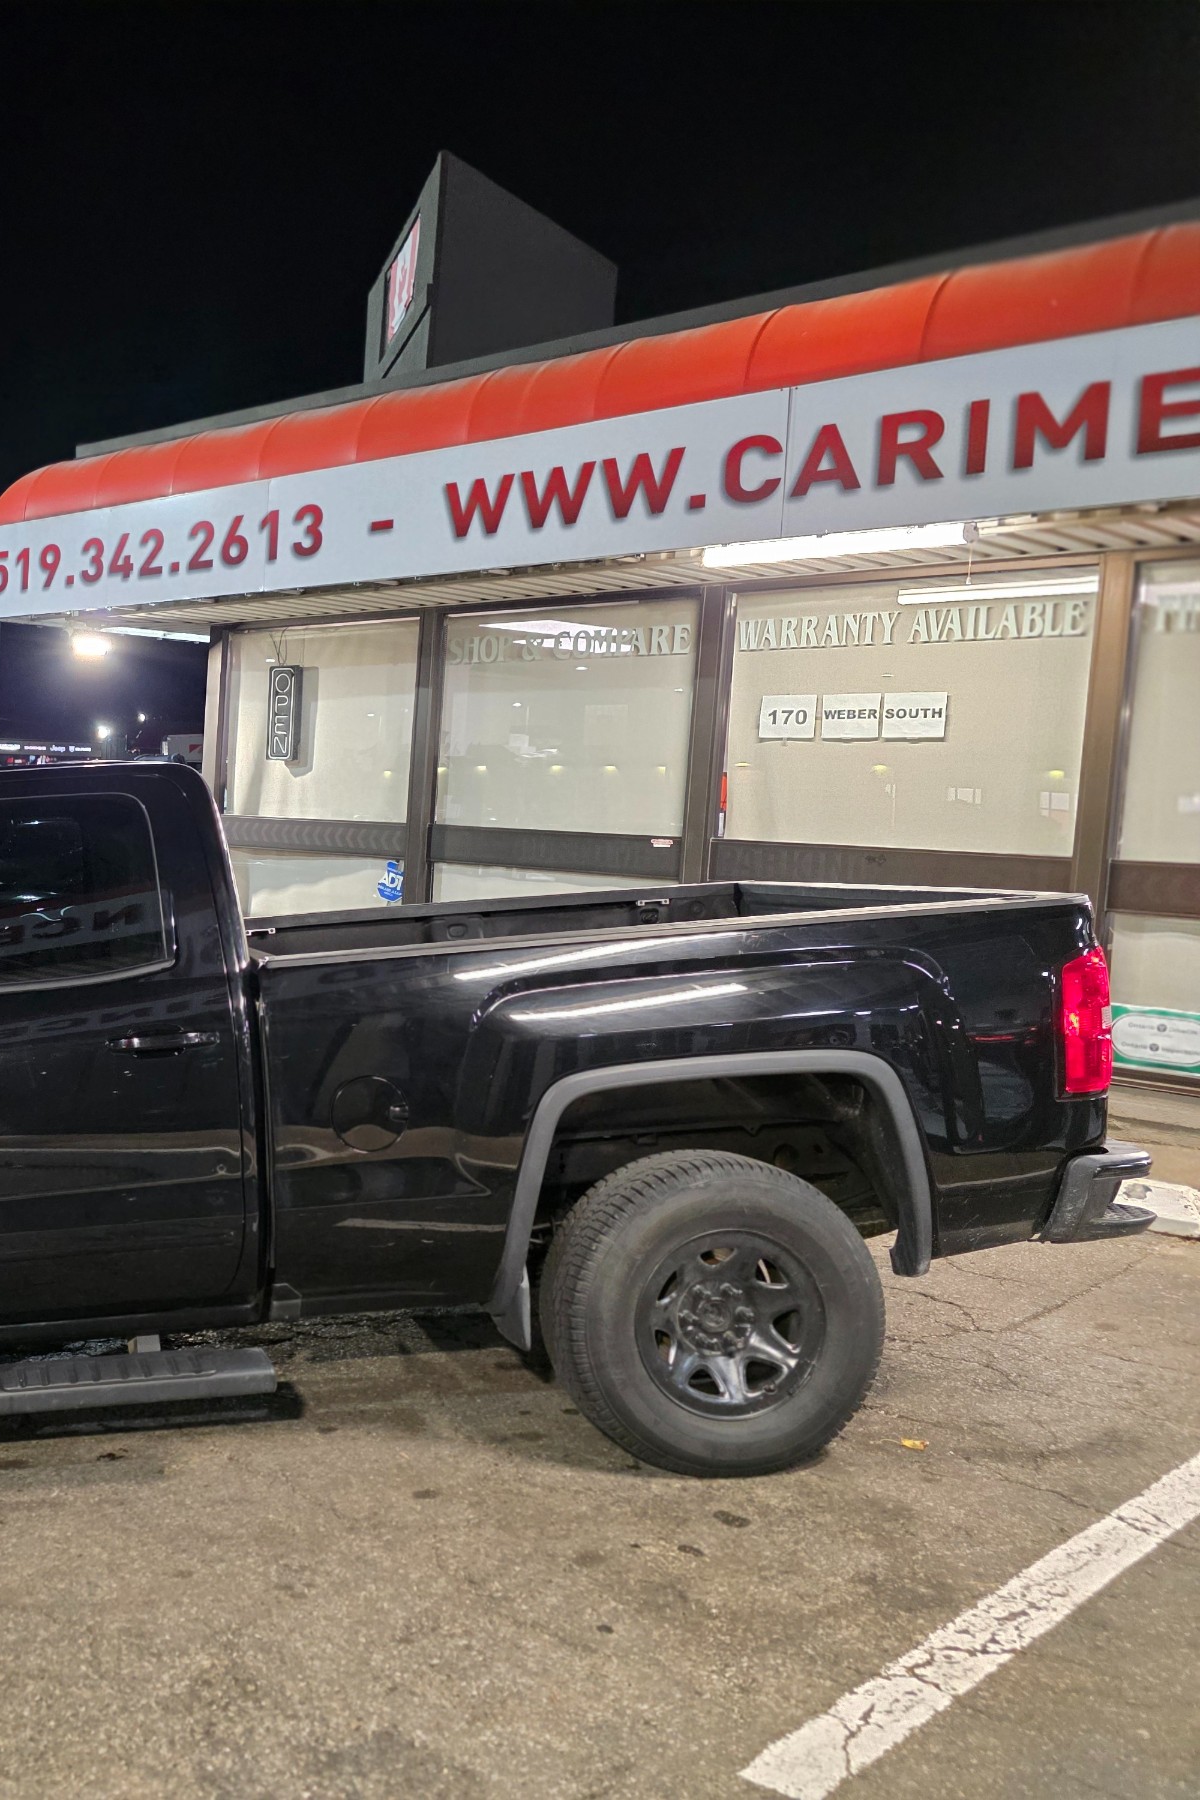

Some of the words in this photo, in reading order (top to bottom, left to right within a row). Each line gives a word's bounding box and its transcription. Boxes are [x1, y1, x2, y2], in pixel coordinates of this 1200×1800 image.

[445, 366, 1200, 539] WWW.CARIME
[450, 634, 514, 666] SHOP
[522, 637, 544, 662] &
[552, 623, 692, 662] COMPARE
[737, 609, 901, 652] WARRANTY
[907, 599, 1089, 644] AVAILABLE
[273, 673, 291, 754] OPEN
[767, 709, 808, 726] 170
[823, 708, 878, 720] WEBER
[884, 706, 943, 720] SOUTH
[378, 870, 404, 891] ADT
